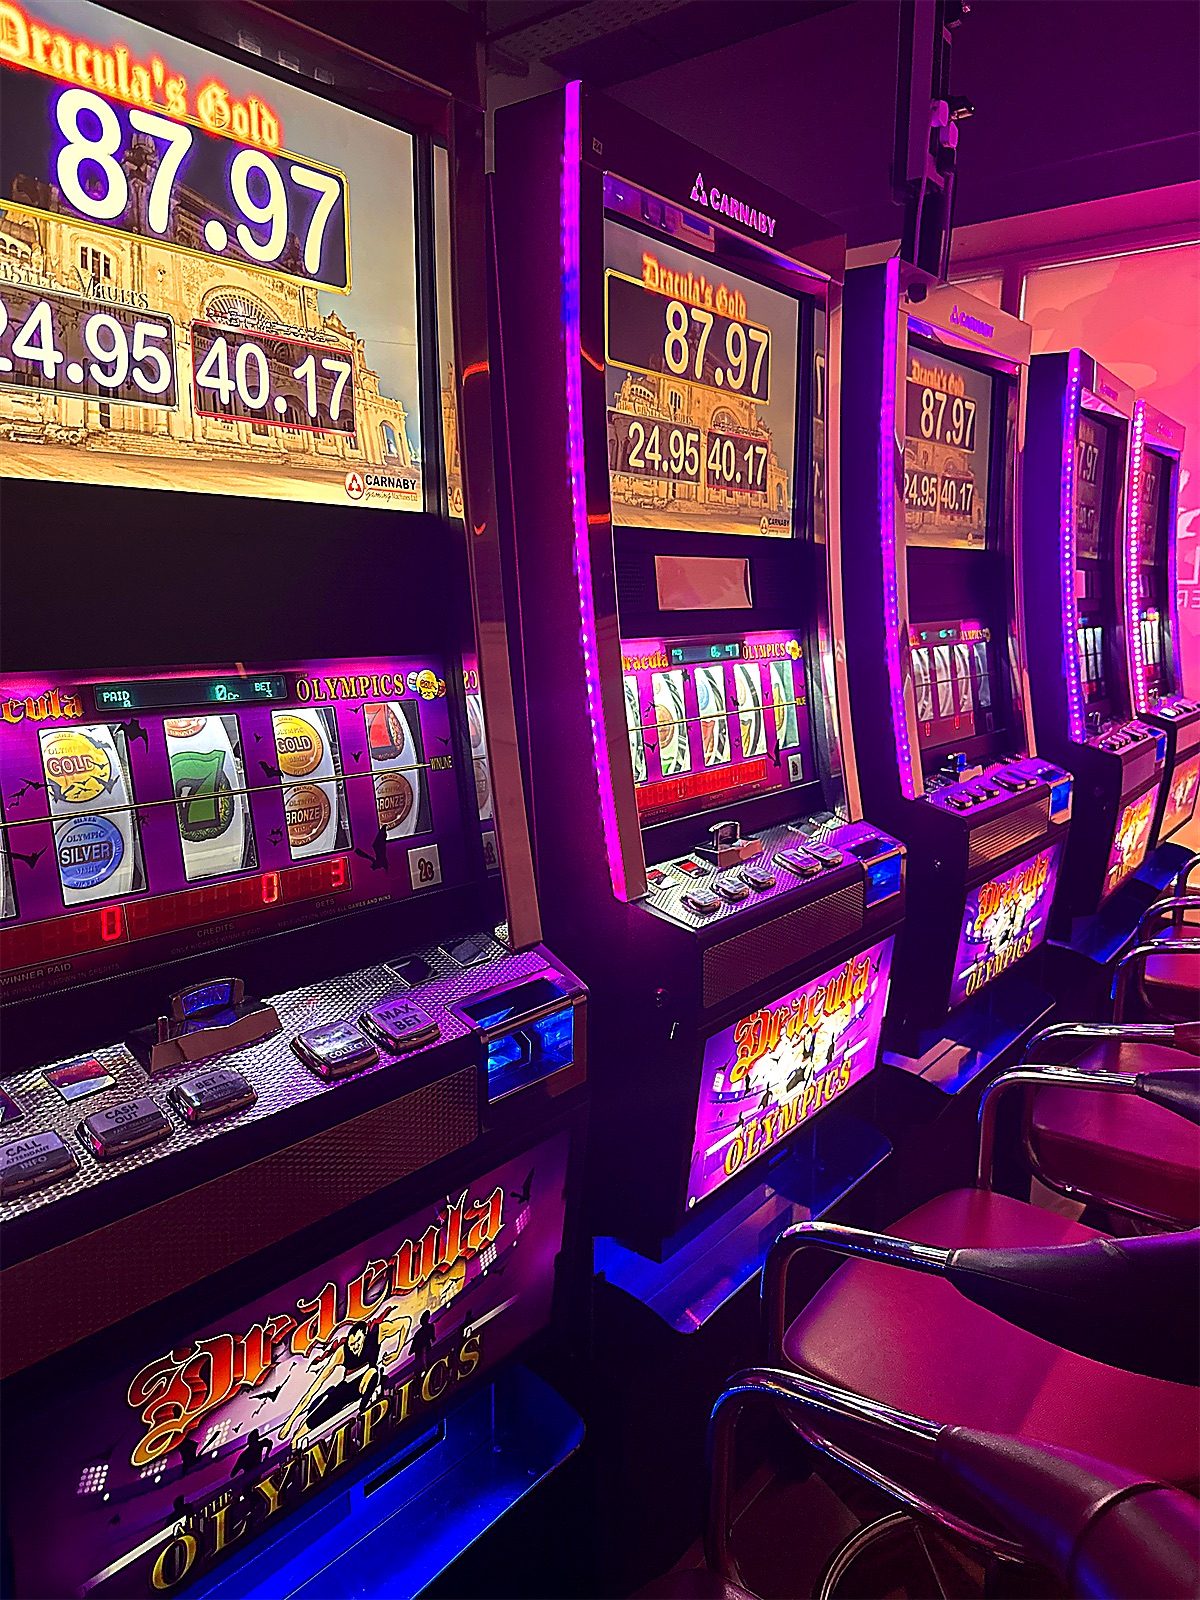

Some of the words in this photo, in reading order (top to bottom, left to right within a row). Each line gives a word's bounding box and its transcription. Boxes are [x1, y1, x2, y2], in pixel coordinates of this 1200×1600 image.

[0, 6, 188, 116] Dracula's
[198, 82, 281, 149] Gold
[56, 88, 342, 275] 87.97
[709, 187, 776, 238] CARNABY
[715, 283, 747, 320] Gold
[664, 300, 769, 395] 87.97
[196, 336, 352, 421] 40.17
[921, 387, 976, 448] 87.97
[628, 422, 699, 476] 24.95
[708, 437, 767, 486] 40.17
[365, 474, 417, 491] CARNABY
[940, 479, 973, 511] 40.17
[742, 643, 785, 661] OLYMPICS
[103, 690, 130, 703] PAID
[254, 681, 271, 692] BET
[296, 673, 405, 701] OLYMPICS
[276, 736, 311, 753] GOLD
[48, 755, 95, 776] GOLD
[430, 755, 453, 771] WINLINE
[286, 806, 320, 825] BRONZE
[66, 830, 105, 843] OLYMPIC
[61, 843, 110, 865] SILVER
[197, 922, 235, 938] CREDITS
[965, 930, 1033, 997] OLYMPICS
[0, 969, 44, 986] WINNER
[47, 963, 72, 975] PAID
[378, 1003, 415, 1021] MAX
[393, 1013, 421, 1031] BET
[728, 955, 872, 1084] Dracula
[328, 1042, 366, 1059] COLLECT
[195, 1077, 217, 1090] BET
[104, 1102, 139, 1120] CASH
[114, 1111, 139, 1124] OUT
[724, 1057, 852, 1176] OLYMPICS
[5, 1140, 42, 1157] CALL
[6, 1145, 50, 1165] ATTENDANT
[20, 1155, 48, 1170] INFO
[126, 1185, 506, 1467] Dracula
[151, 1334, 484, 1591] OLYMPICS
[200, 1488, 234, 1518] THE
